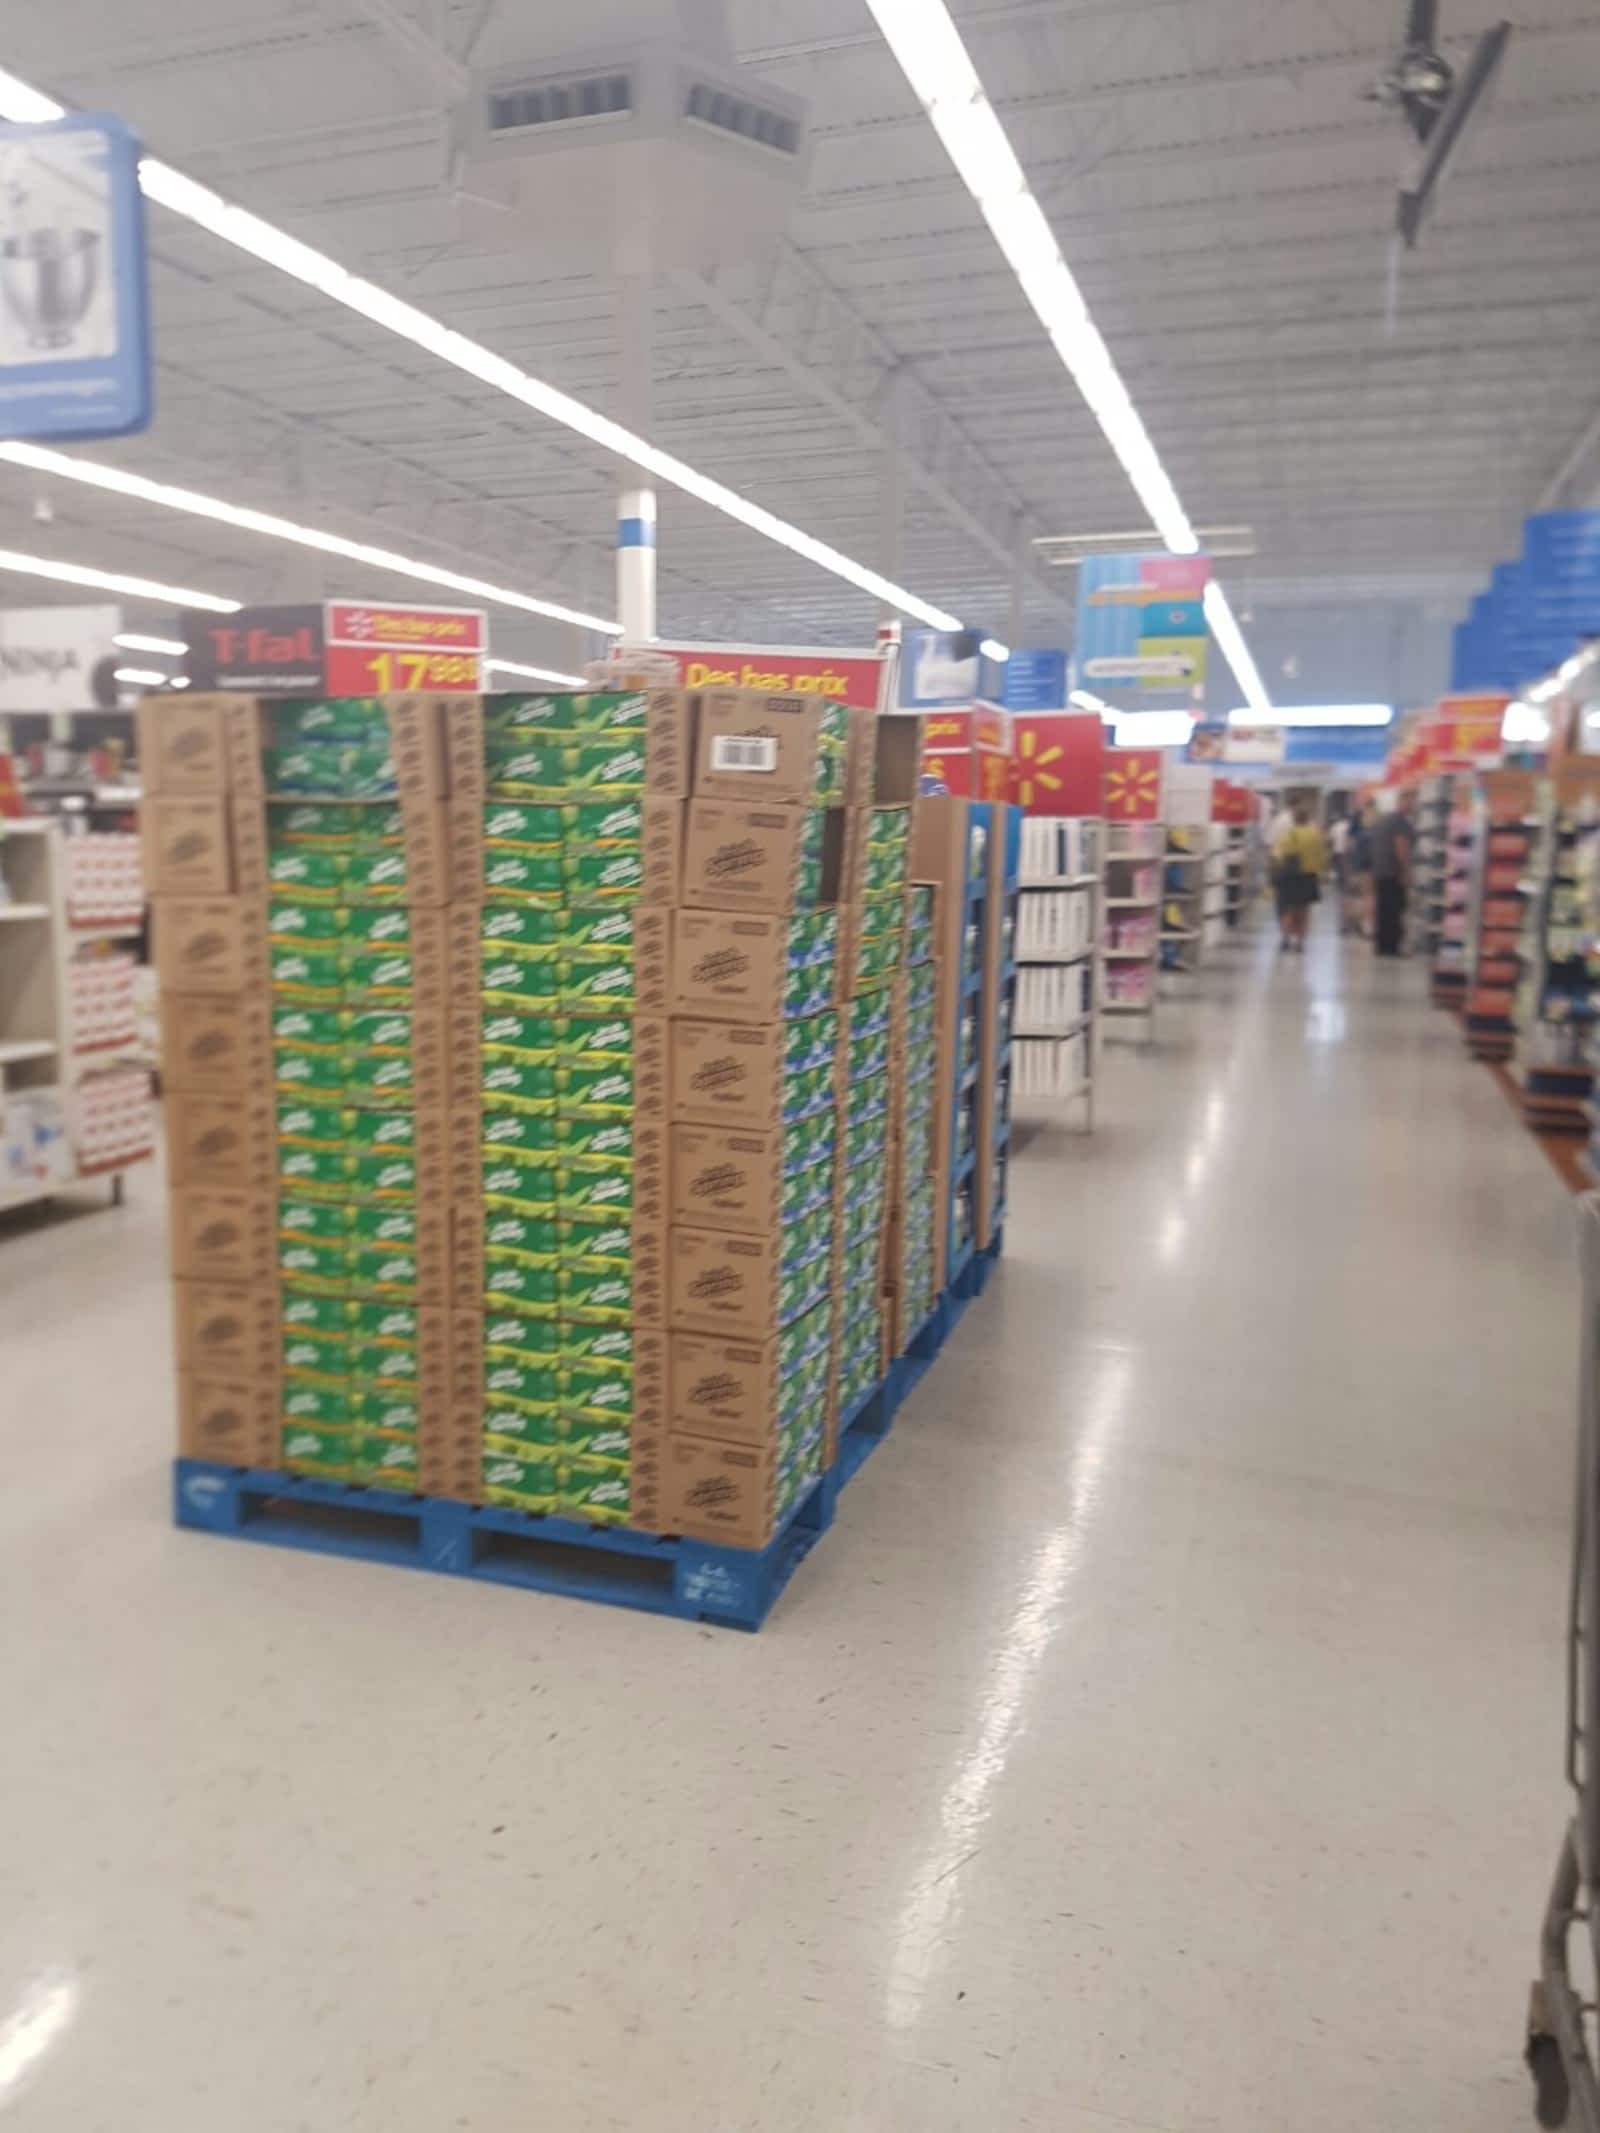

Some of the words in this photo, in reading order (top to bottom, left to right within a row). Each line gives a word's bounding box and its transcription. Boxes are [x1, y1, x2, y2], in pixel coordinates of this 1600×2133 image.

[686, 663, 737, 689] Des
[740, 664, 790, 691] bas
[792, 669, 848, 696] prix
